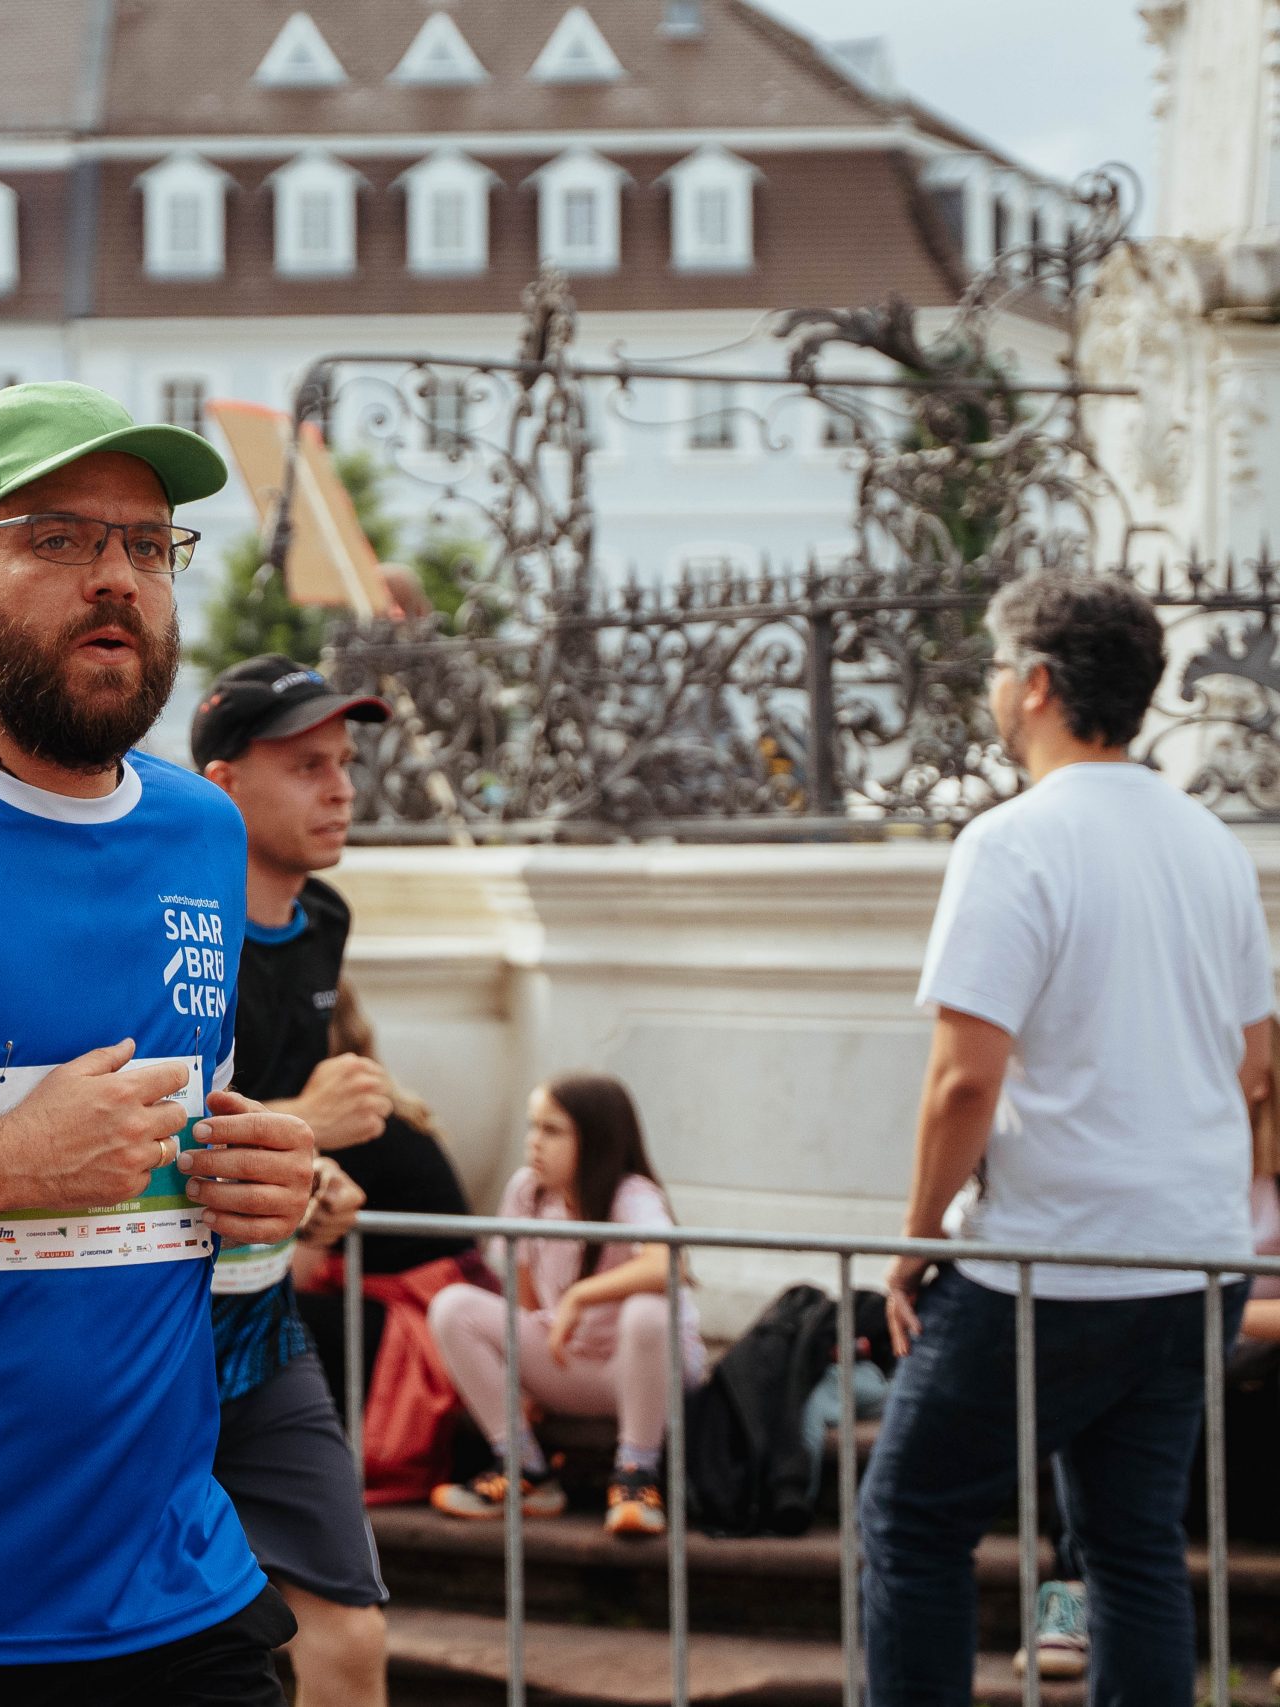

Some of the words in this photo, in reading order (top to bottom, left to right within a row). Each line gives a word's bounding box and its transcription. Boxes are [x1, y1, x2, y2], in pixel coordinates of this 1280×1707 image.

[158, 894, 219, 909] Landeshauptstadt
[164, 908, 223, 946] SAAR
[172, 982, 226, 1018] CKEN
